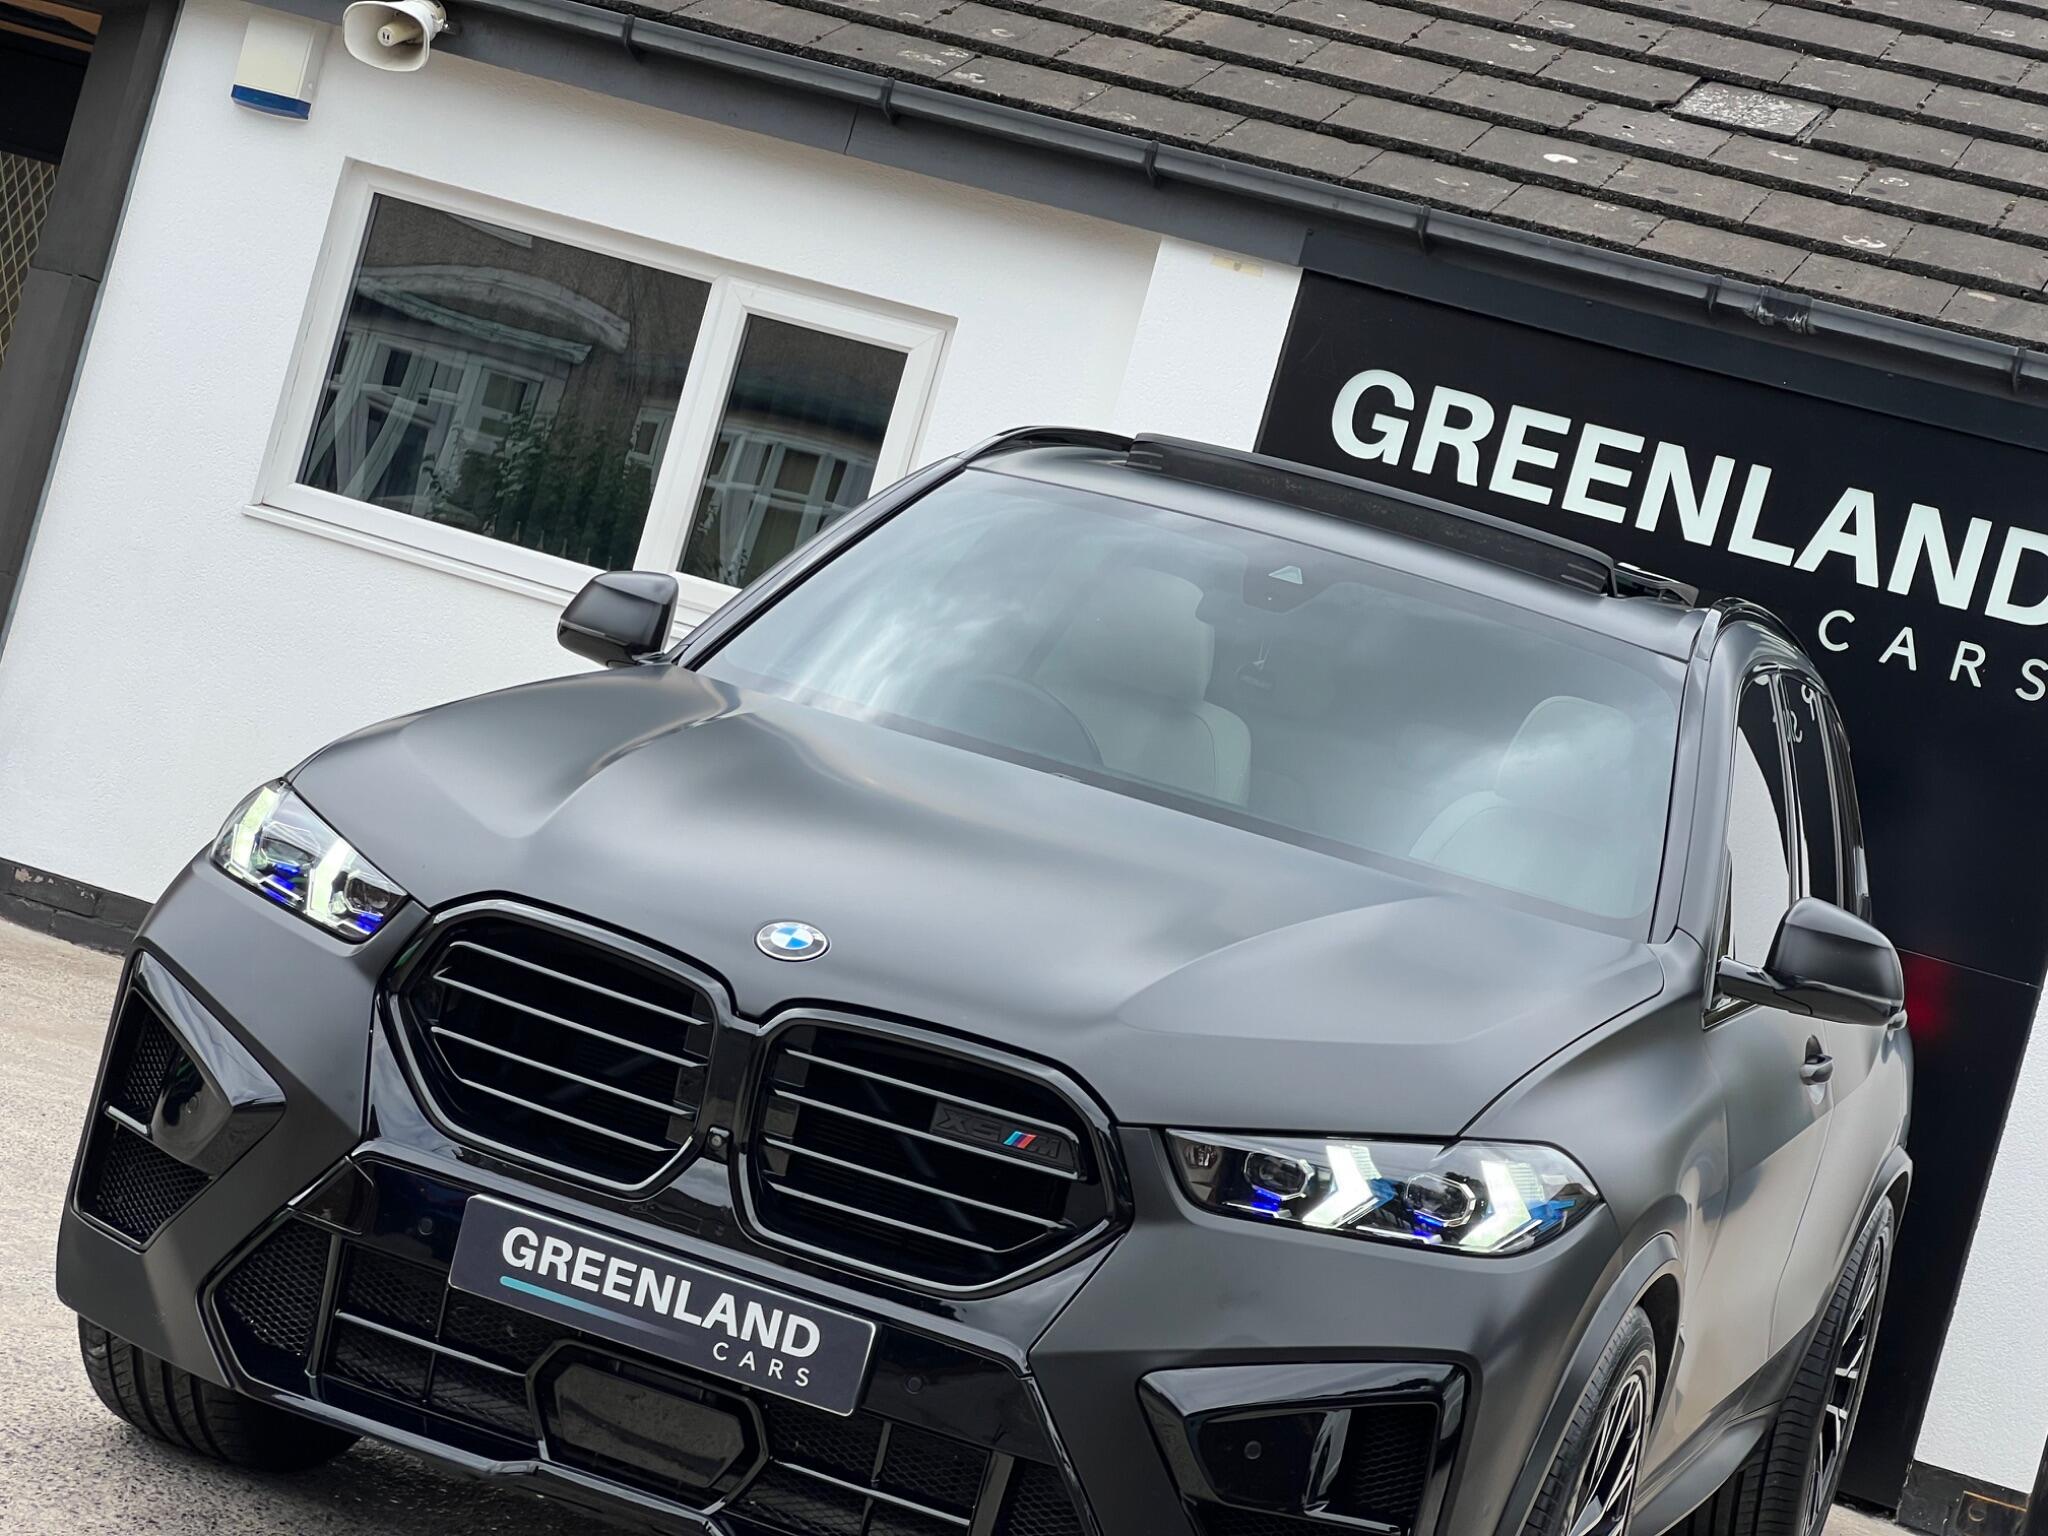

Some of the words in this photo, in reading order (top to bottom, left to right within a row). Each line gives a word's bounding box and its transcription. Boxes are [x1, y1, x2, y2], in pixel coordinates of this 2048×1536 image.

[1331, 369, 2048, 625] GREENLAND
[1818, 609, 2048, 701] CARS
[502, 1226, 821, 1358] GREENLAND
[712, 1341, 810, 1387] CARS
